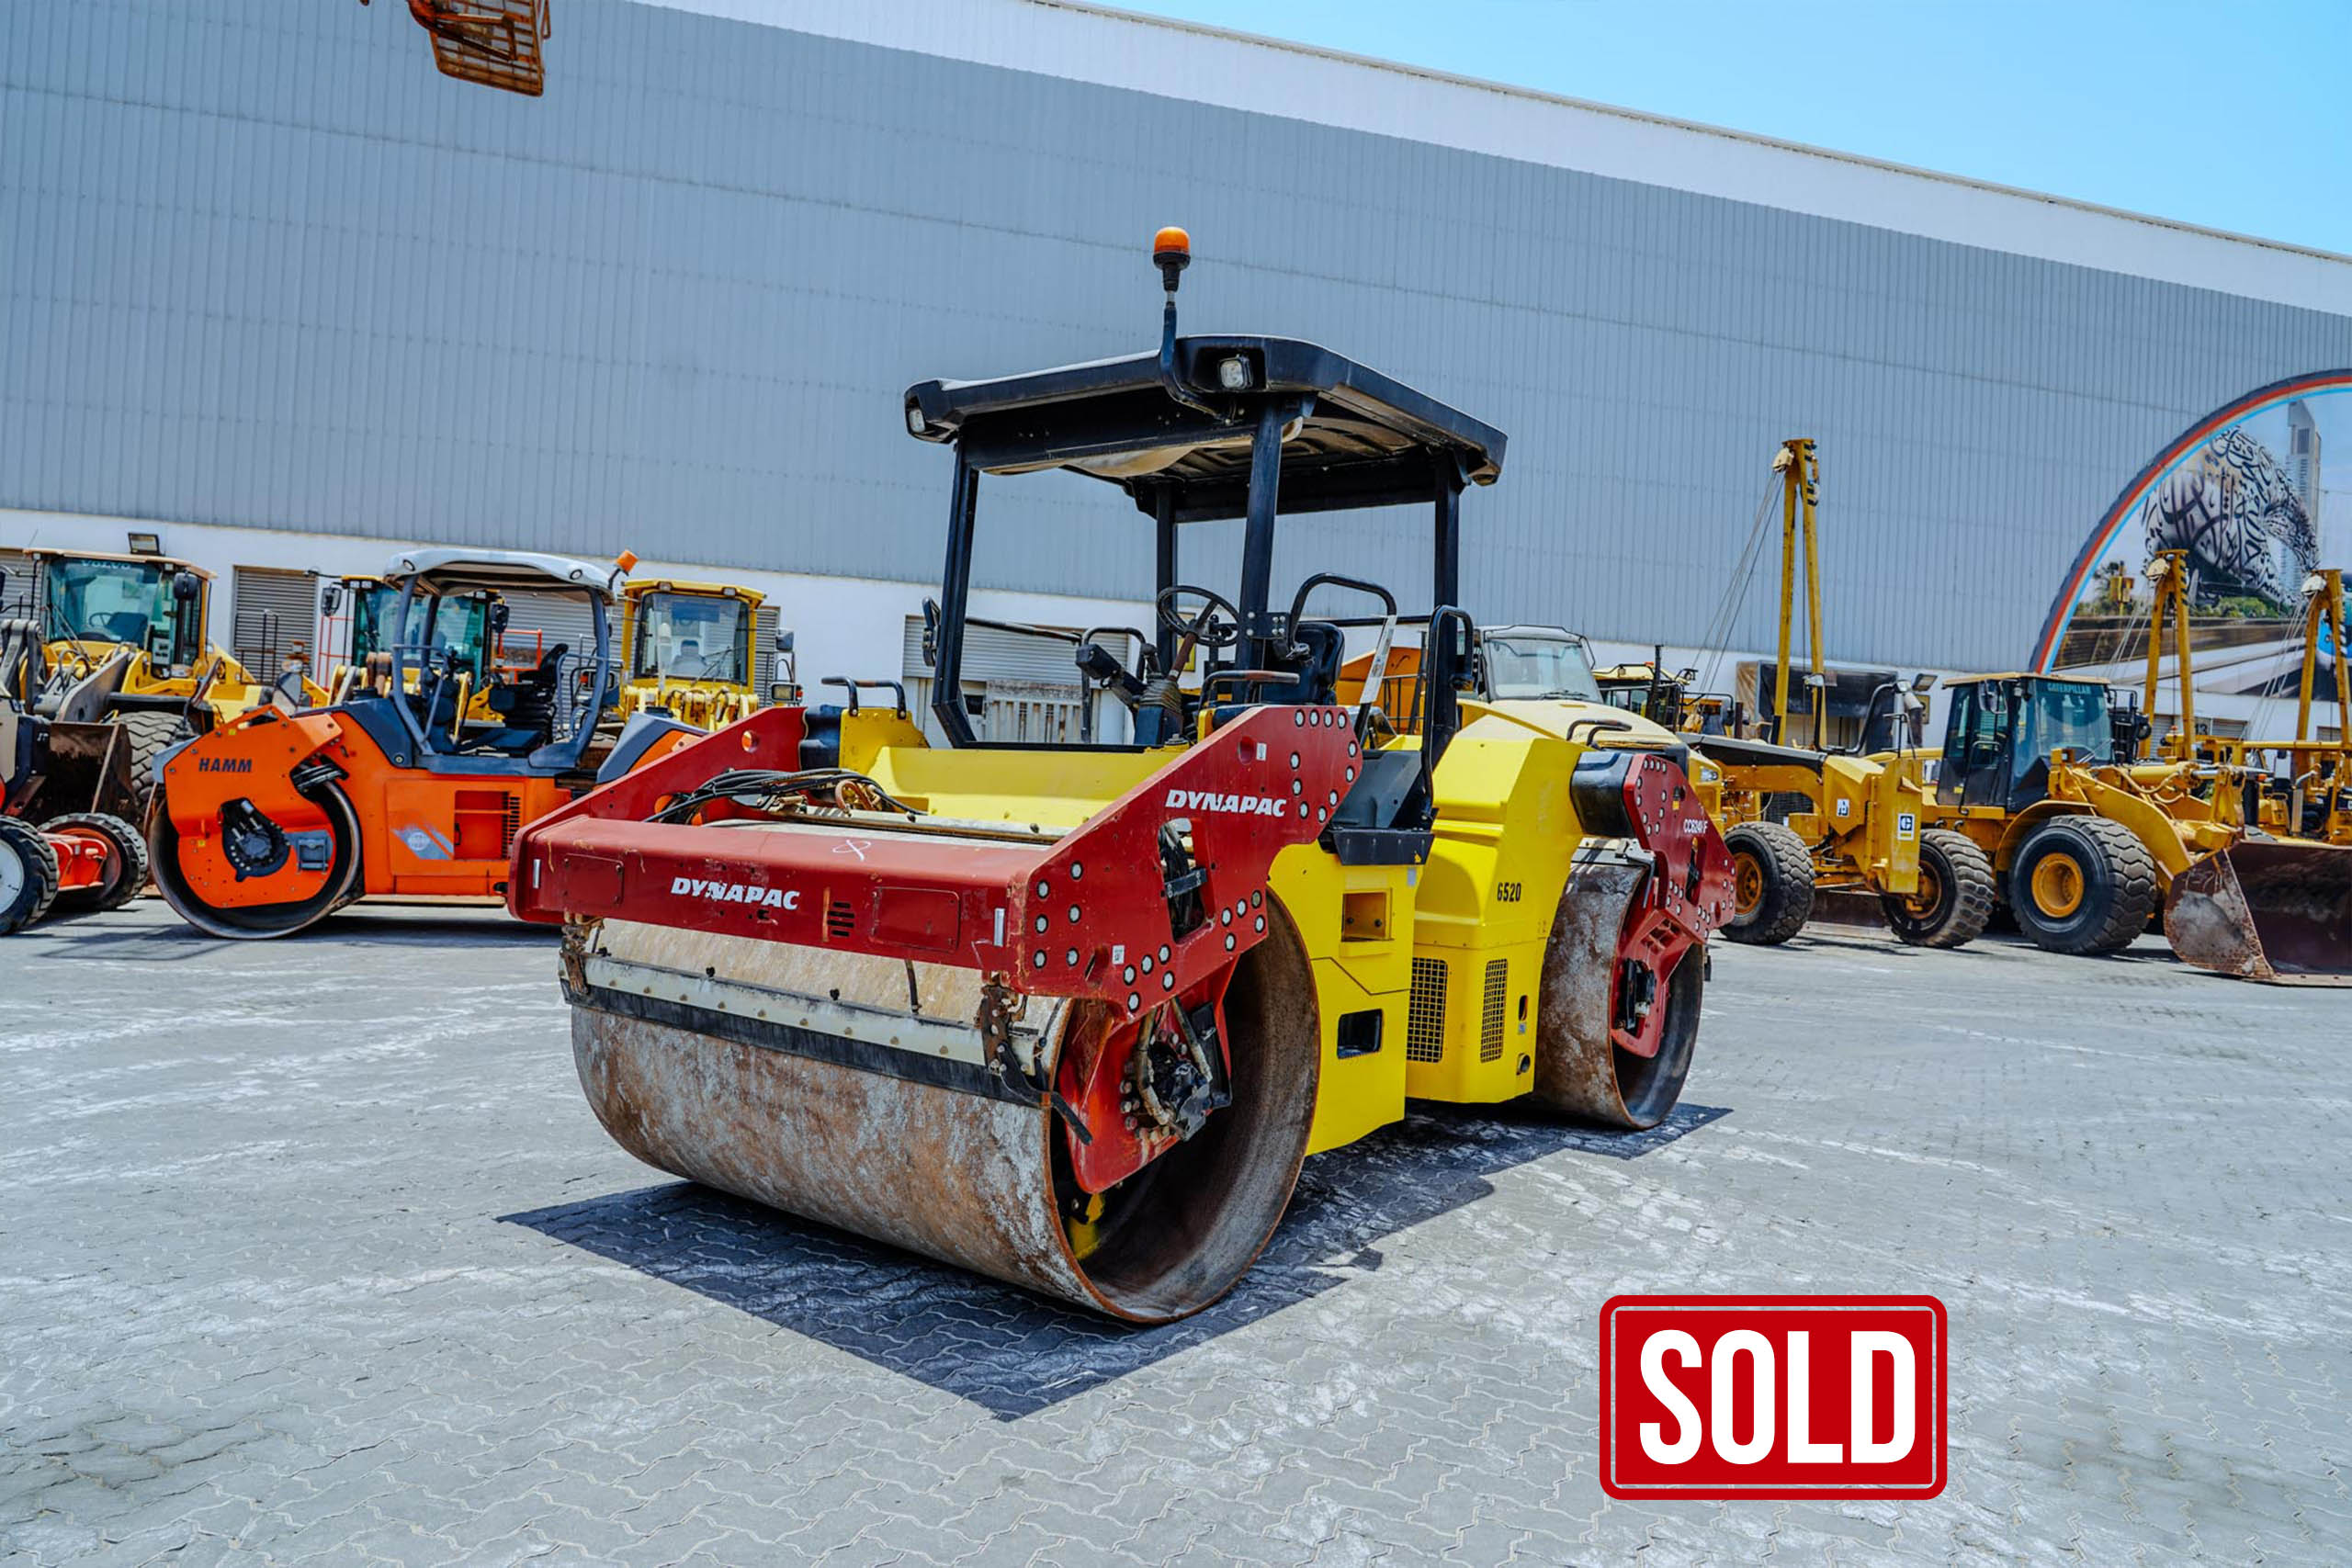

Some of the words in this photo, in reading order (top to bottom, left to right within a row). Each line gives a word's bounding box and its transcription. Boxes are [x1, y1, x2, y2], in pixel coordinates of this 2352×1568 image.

[198, 757, 253, 773] HAMM
[1165, 789, 1287, 818] DYNAPAC
[671, 876, 800, 910] DYNAPAC
[1497, 882, 1521, 902] 6520
